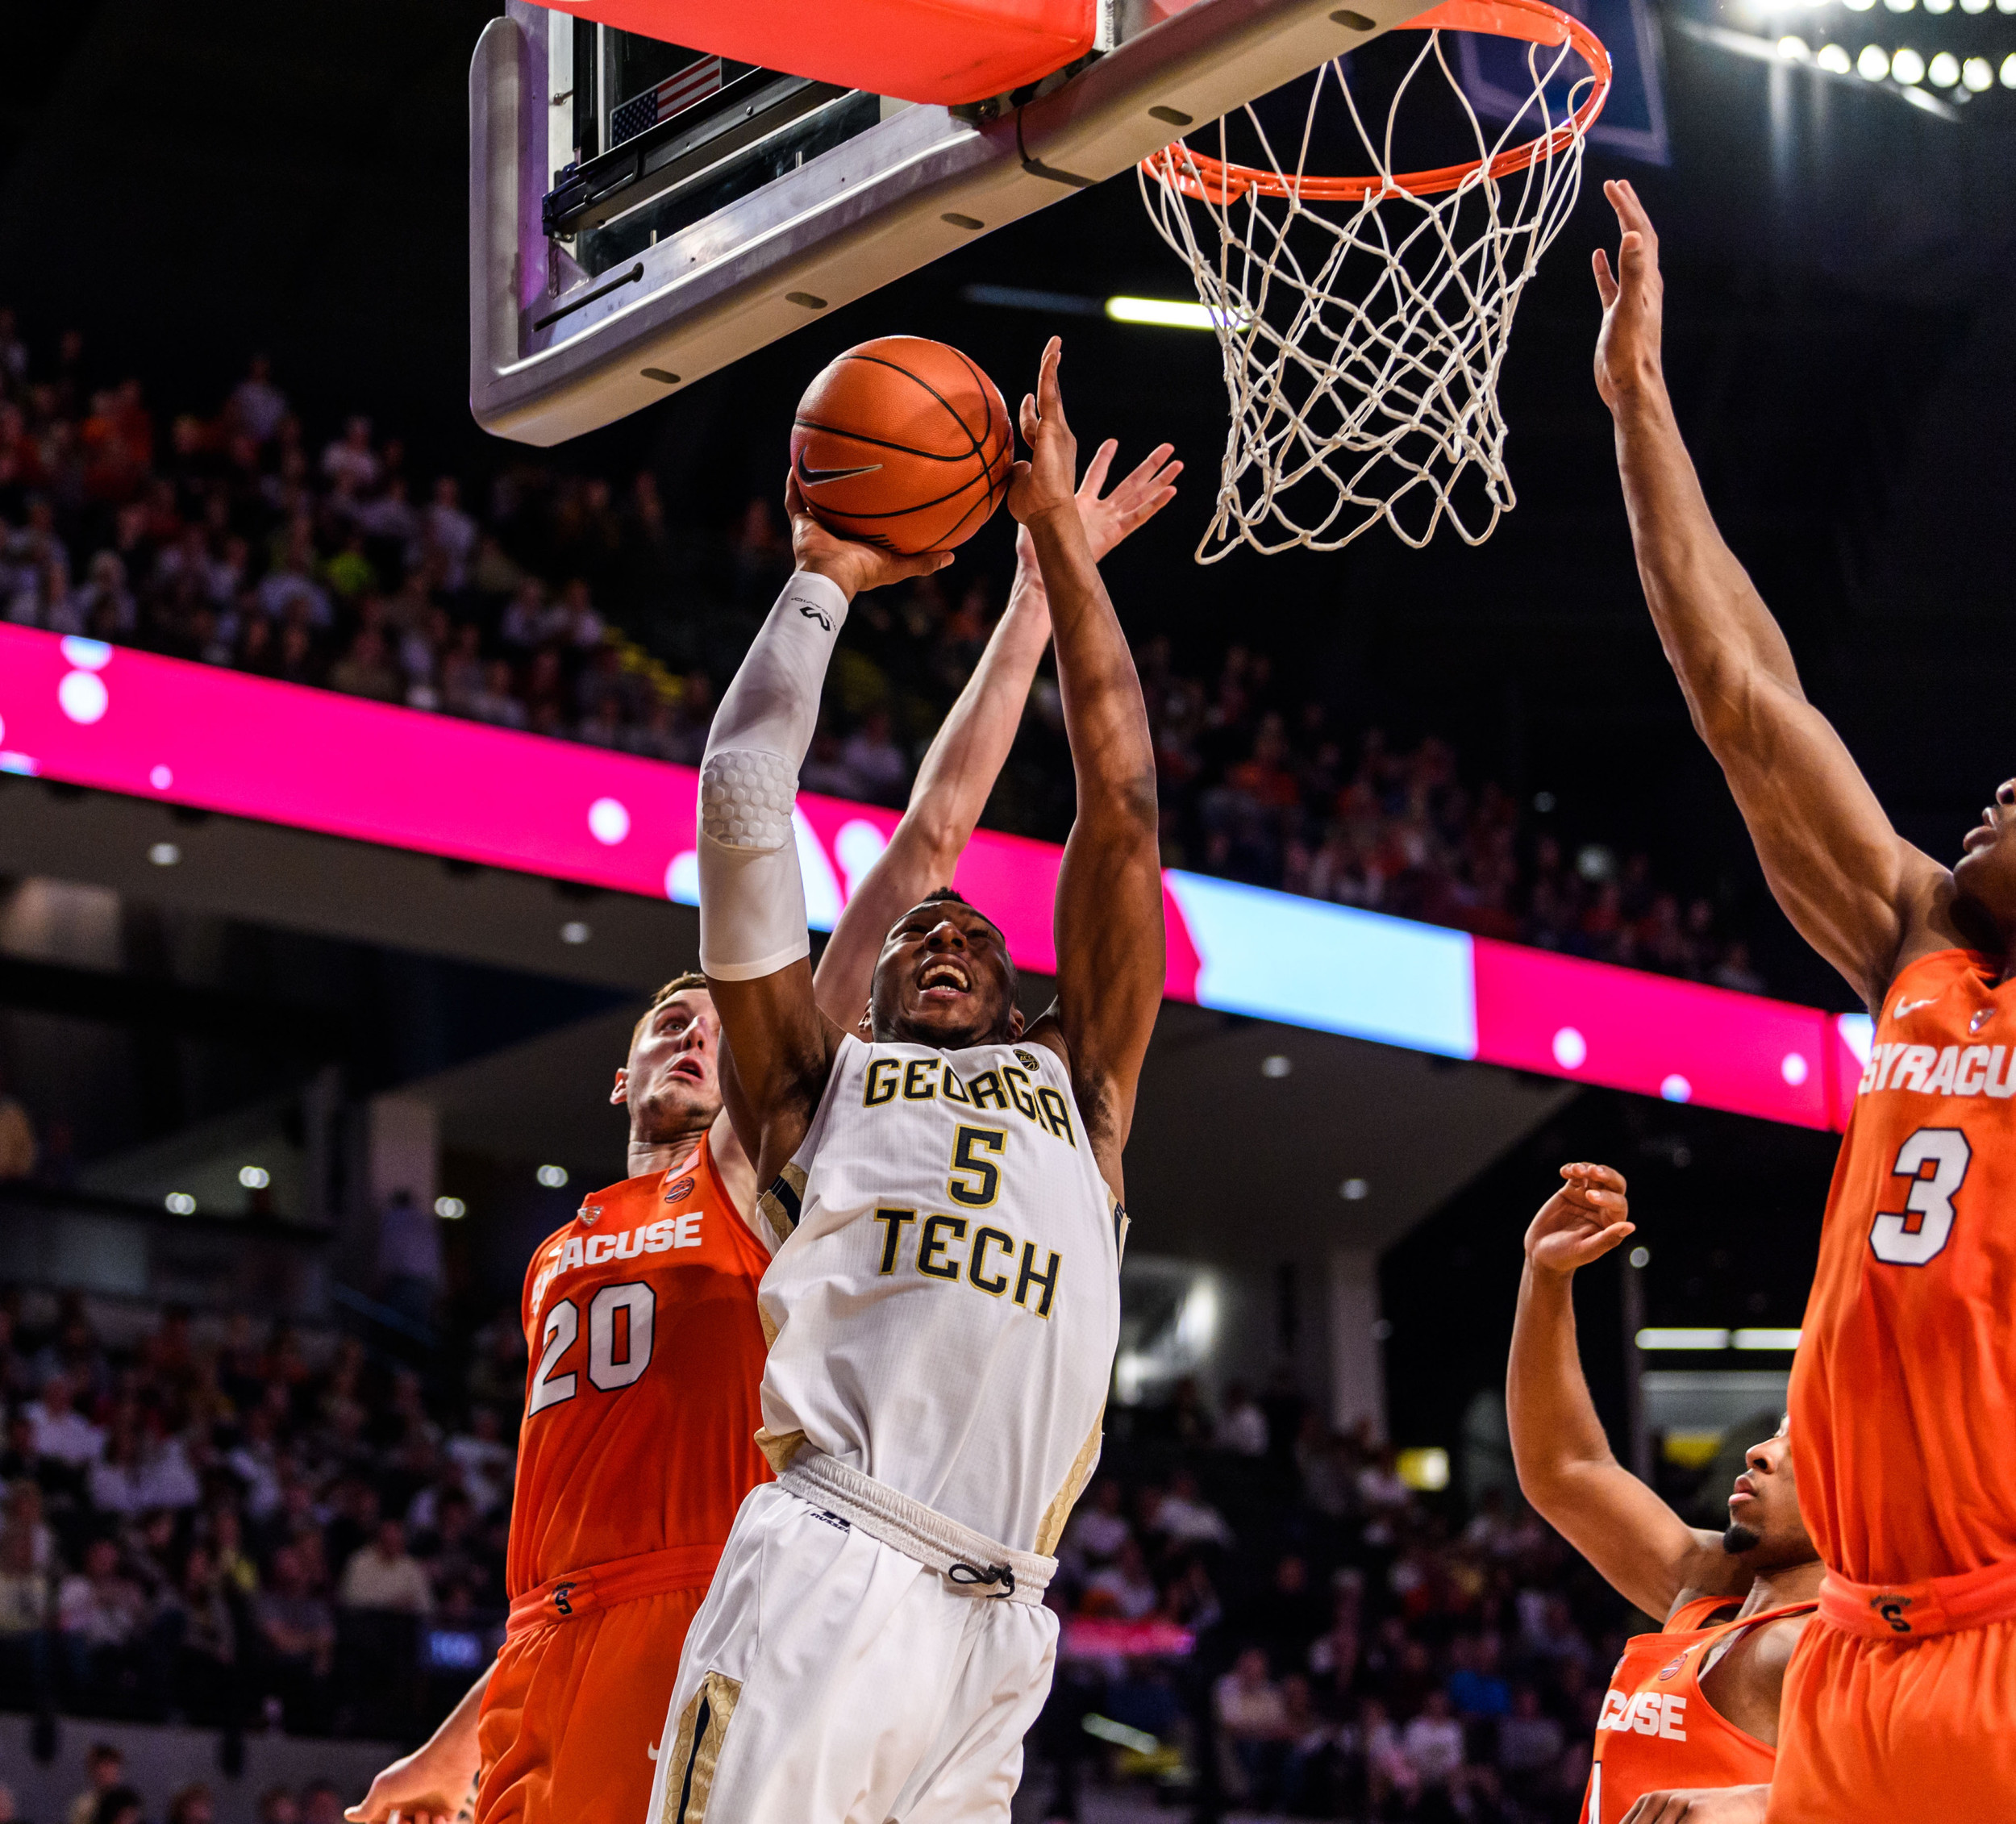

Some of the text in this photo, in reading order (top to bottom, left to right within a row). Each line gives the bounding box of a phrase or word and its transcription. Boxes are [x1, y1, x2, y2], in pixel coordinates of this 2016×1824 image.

[946, 1123, 1007, 1210] 5
[1869, 1126, 1973, 1267] 3
[873, 1207, 1063, 1320] TECH
[527, 1280, 657, 1420] 20
